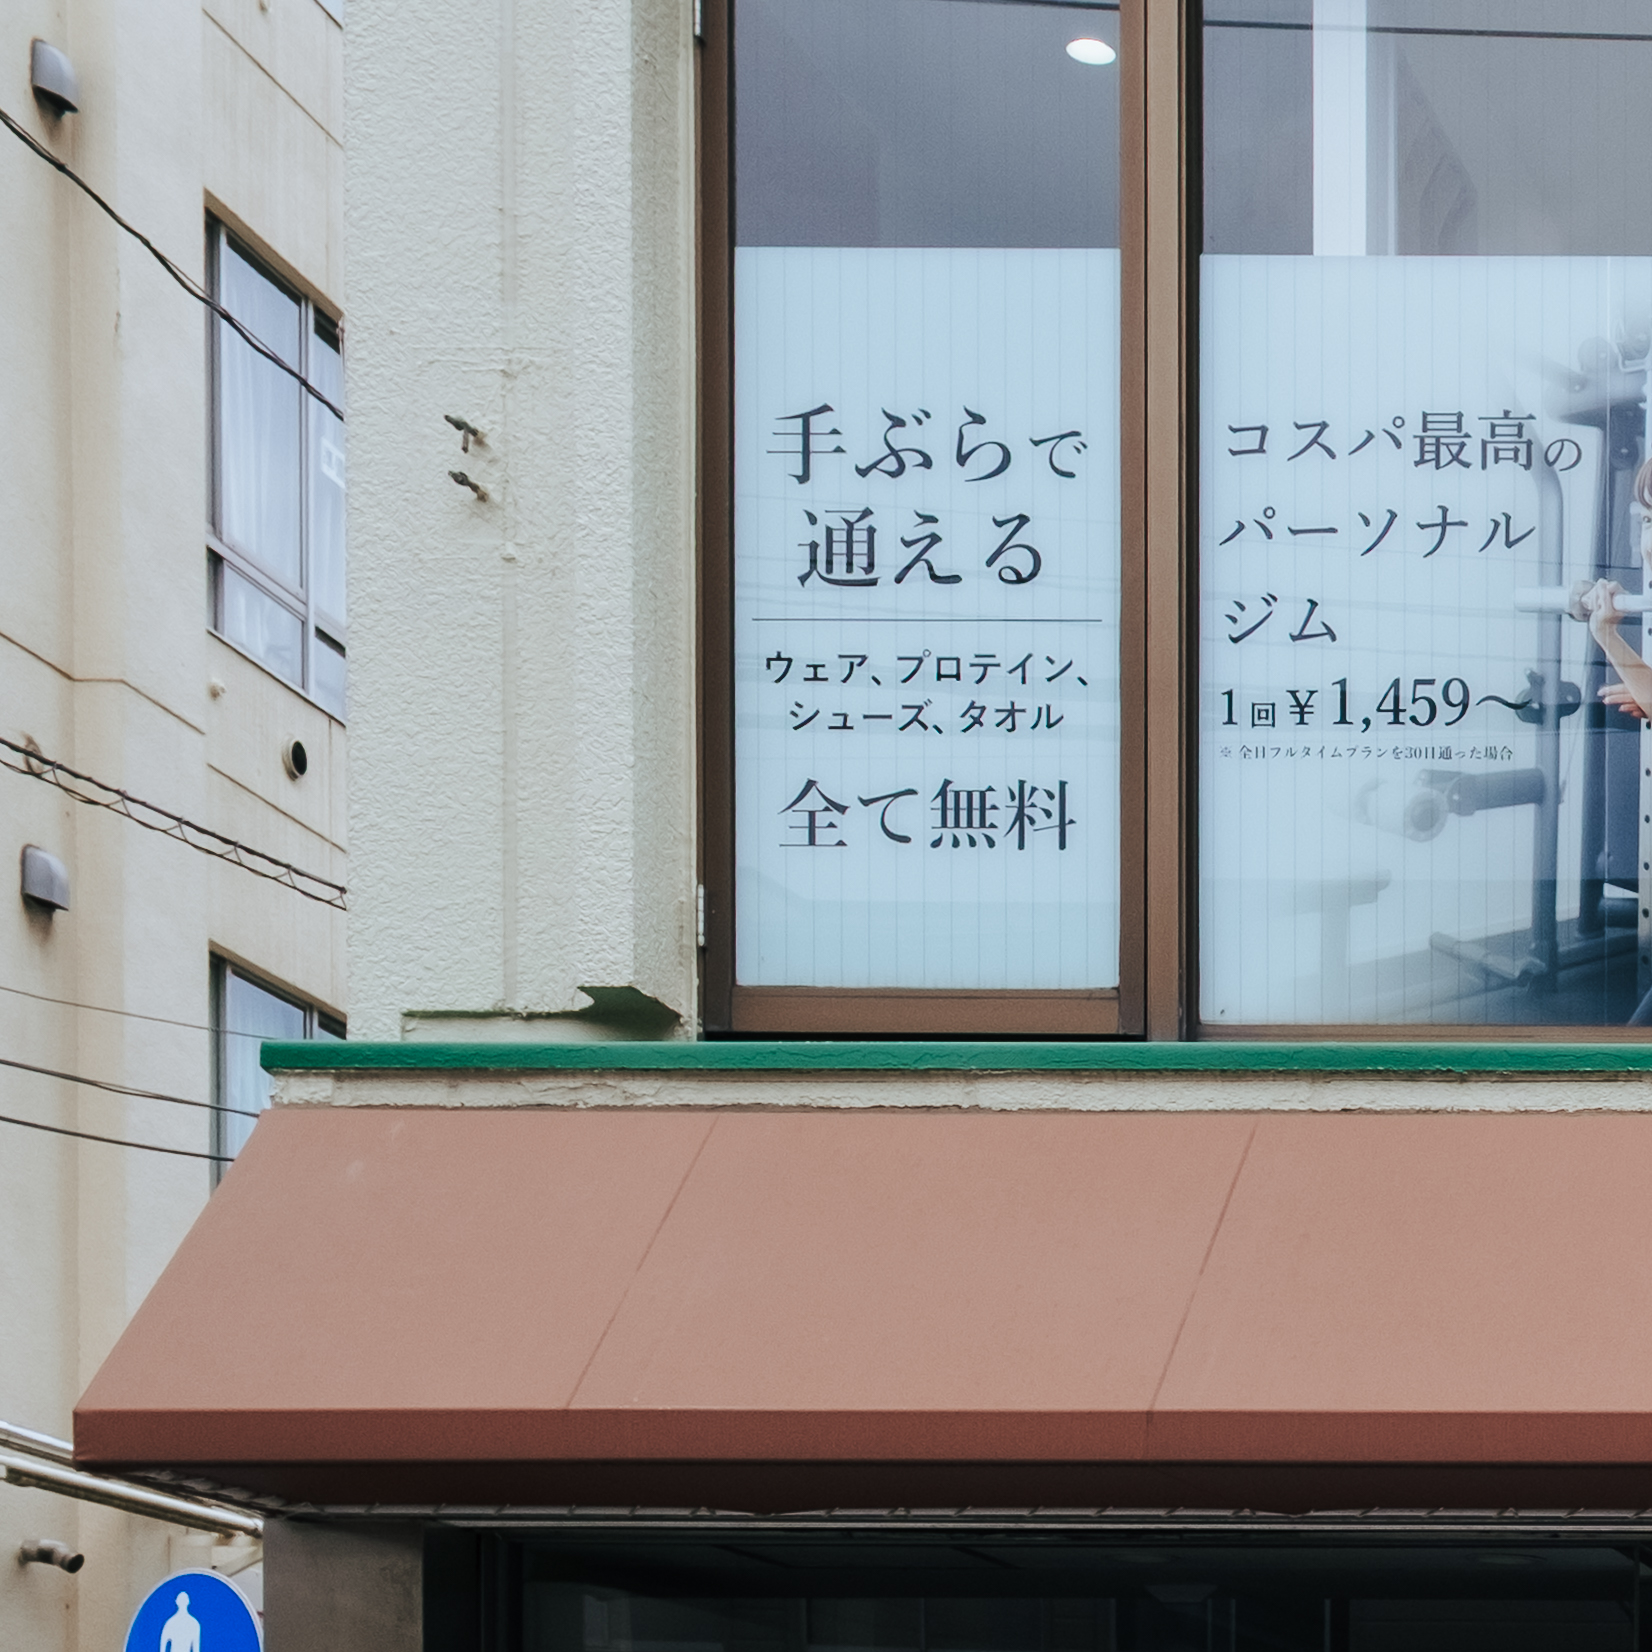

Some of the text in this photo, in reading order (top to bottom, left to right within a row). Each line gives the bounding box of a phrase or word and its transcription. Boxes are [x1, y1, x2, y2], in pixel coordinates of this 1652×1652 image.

[767, 404, 1087, 484] 手ぶらで
[1227, 409, 1584, 473] コスパ最高の
[798, 507, 1041, 587] 通える
[1219, 505, 1535, 558] パーソナル
[1225, 593, 1336, 644] ジム
[790, 699, 1063, 734] シューズ、タオル
[780, 779, 1076, 850] 全て無料
